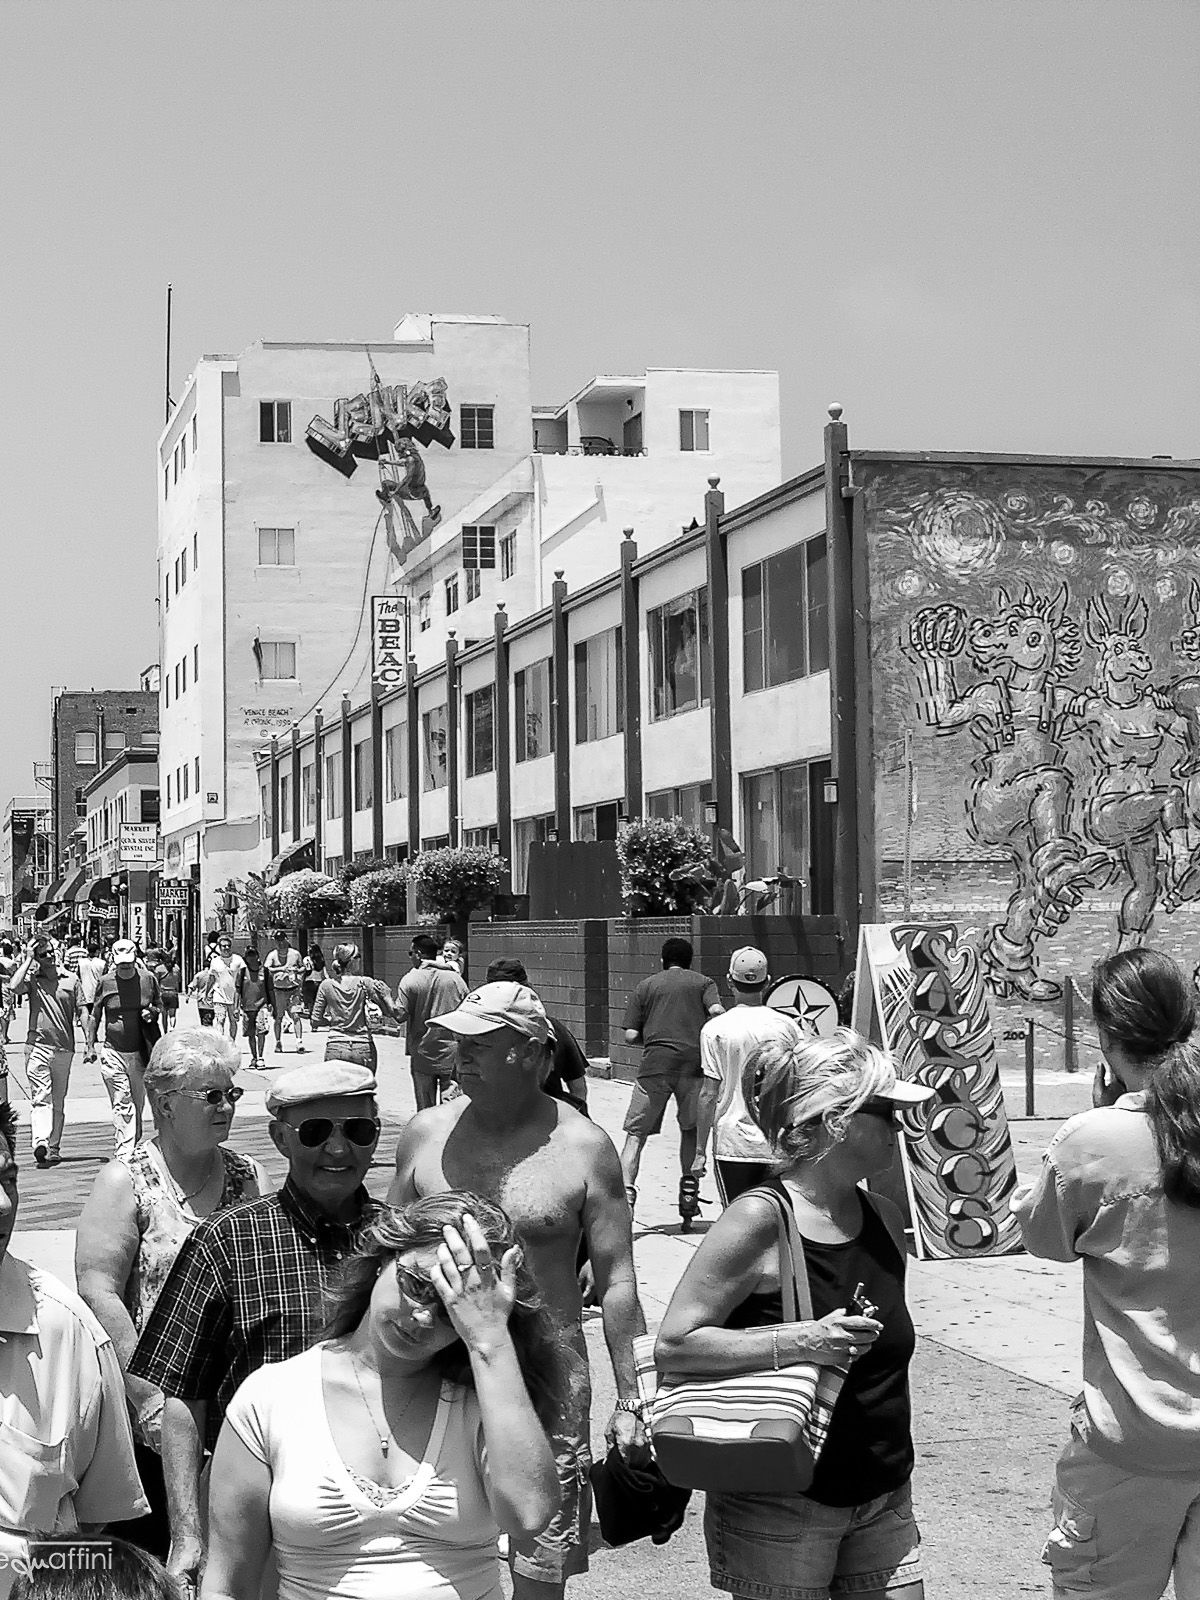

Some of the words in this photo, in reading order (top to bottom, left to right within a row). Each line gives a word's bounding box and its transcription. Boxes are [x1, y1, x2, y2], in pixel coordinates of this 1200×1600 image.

[305, 376, 450, 458] VENICE
[378, 601, 398, 614] The
[378, 618, 402, 689] BEAC
[160, 889, 187, 898] MARKET
[891, 924, 998, 1256] TATTOOS
